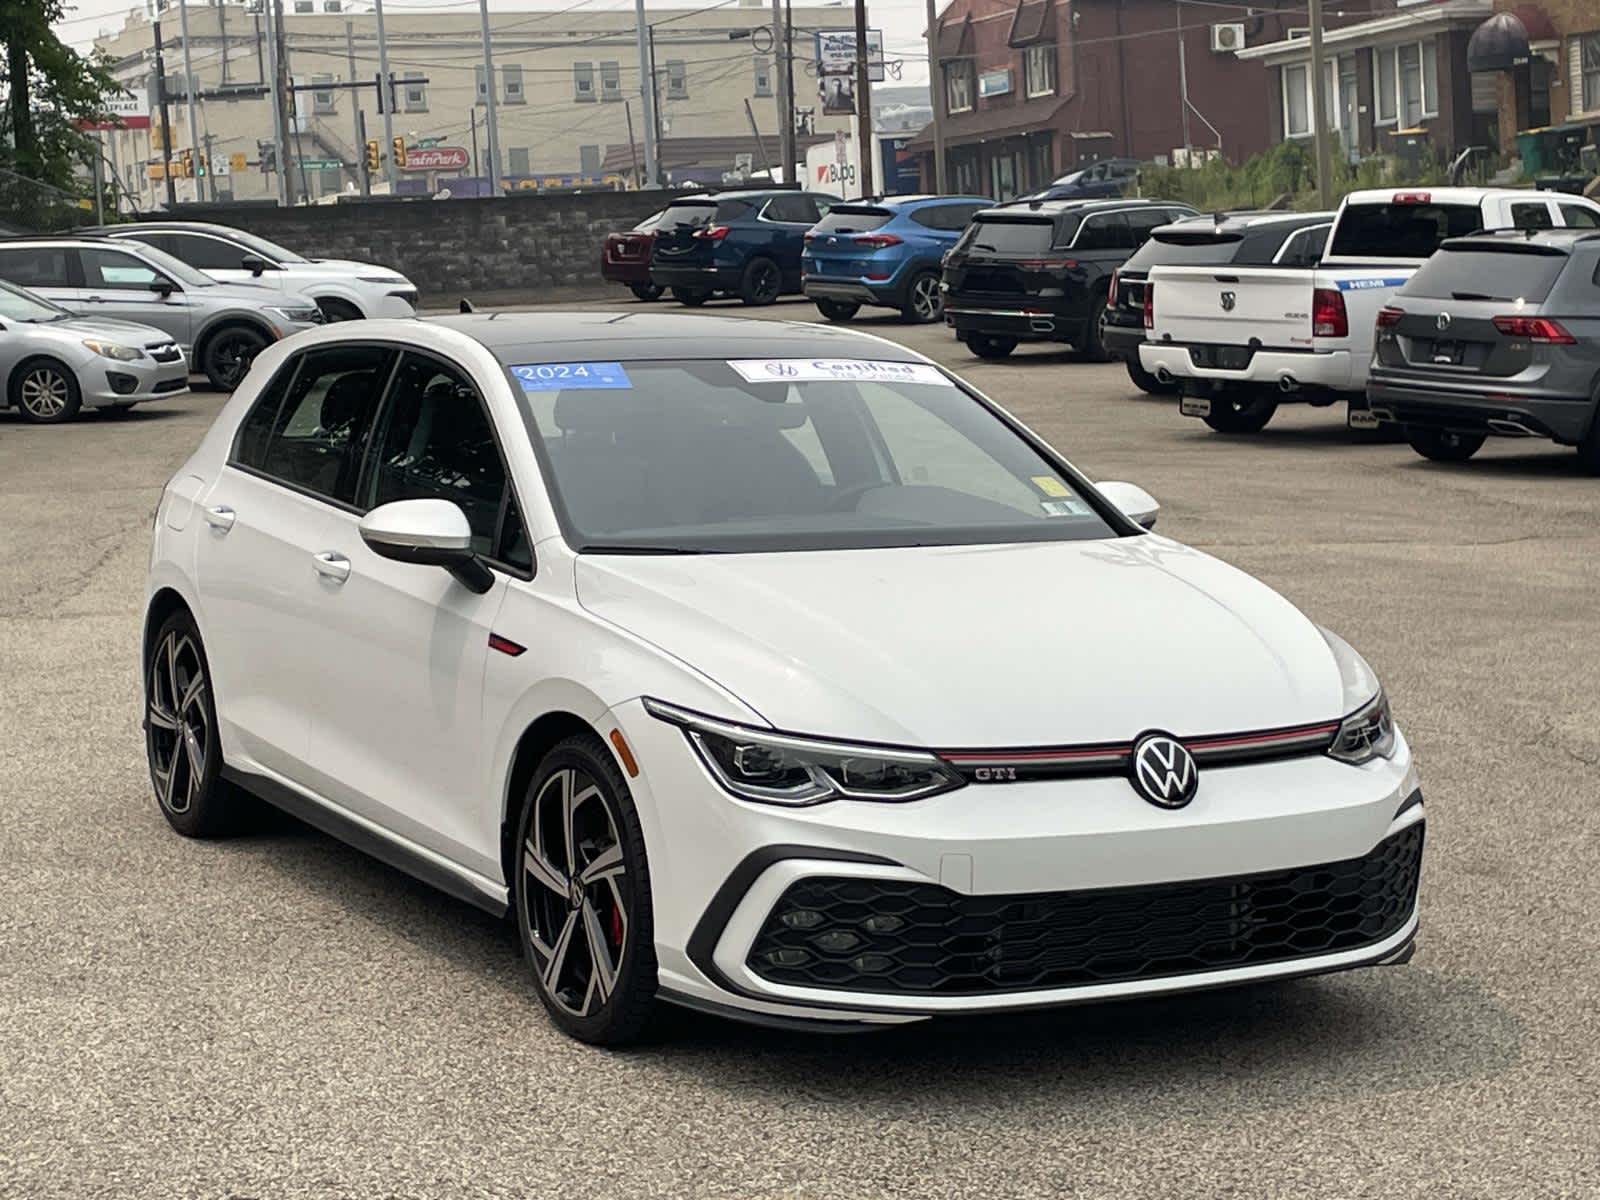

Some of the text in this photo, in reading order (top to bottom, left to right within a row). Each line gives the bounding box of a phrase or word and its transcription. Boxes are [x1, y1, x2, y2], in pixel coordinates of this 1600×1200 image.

[830, 163, 856, 185] Budg
[1349, 279, 1385, 289] HEMI
[518, 365, 589, 379] 2024
[812, 360, 915, 375] Certified
[975, 767, 1017, 781] GTI
